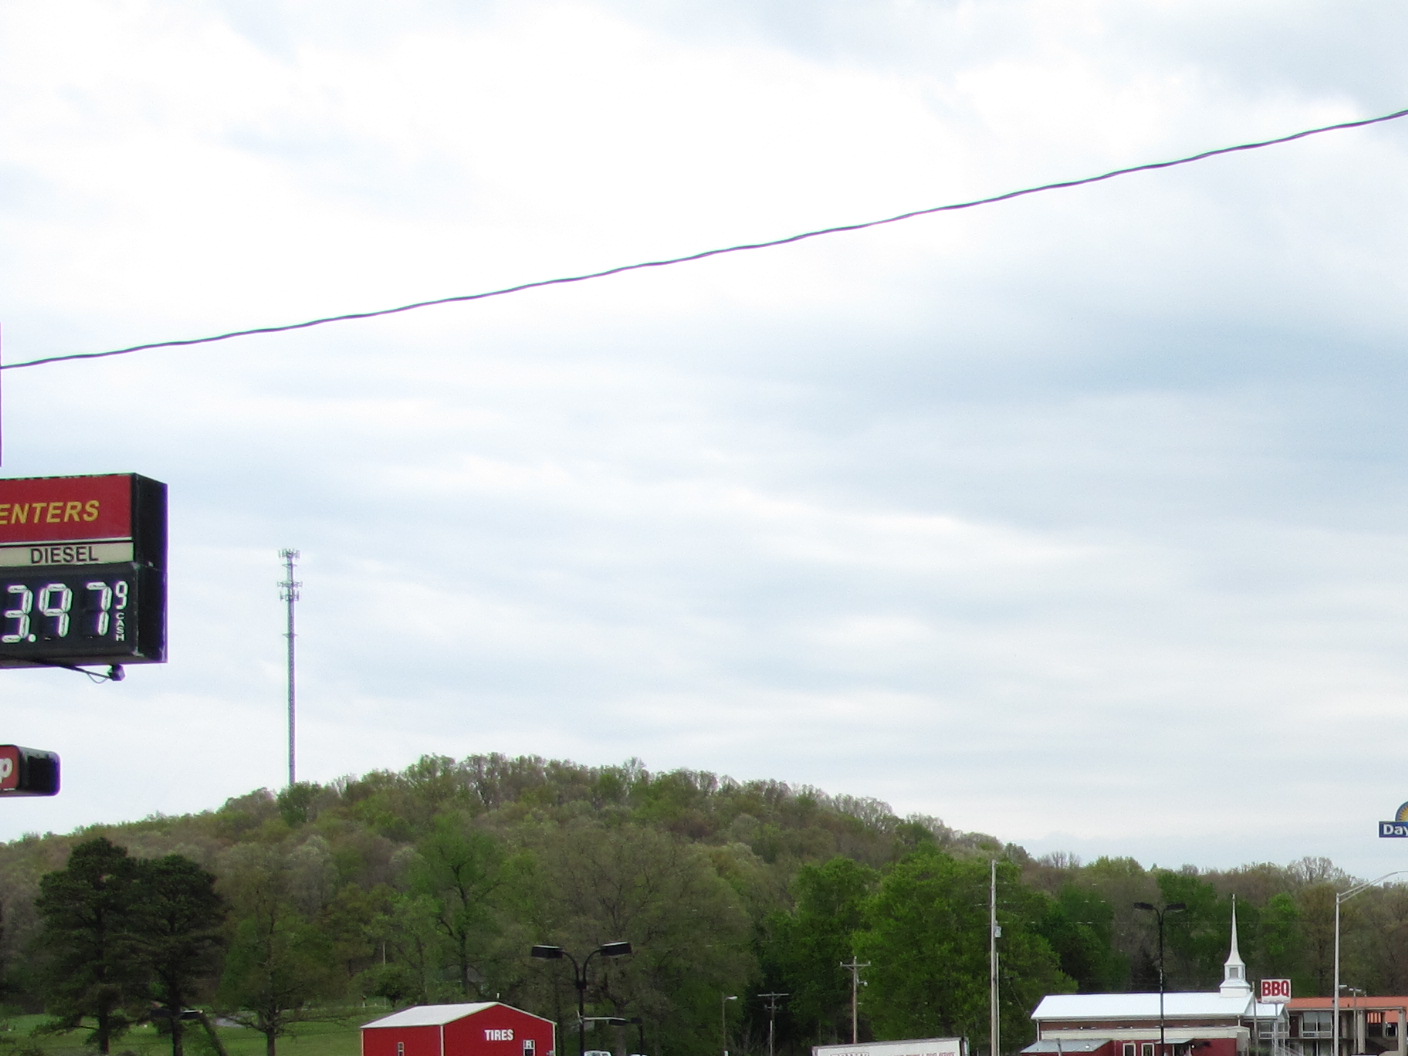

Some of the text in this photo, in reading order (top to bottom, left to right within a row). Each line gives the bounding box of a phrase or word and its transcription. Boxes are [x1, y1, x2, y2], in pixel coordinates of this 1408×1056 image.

[30, 546, 99, 564] DIESEL
[1262, 980, 1290, 997] BBQ
[484, 1029, 514, 1041] TIRES
